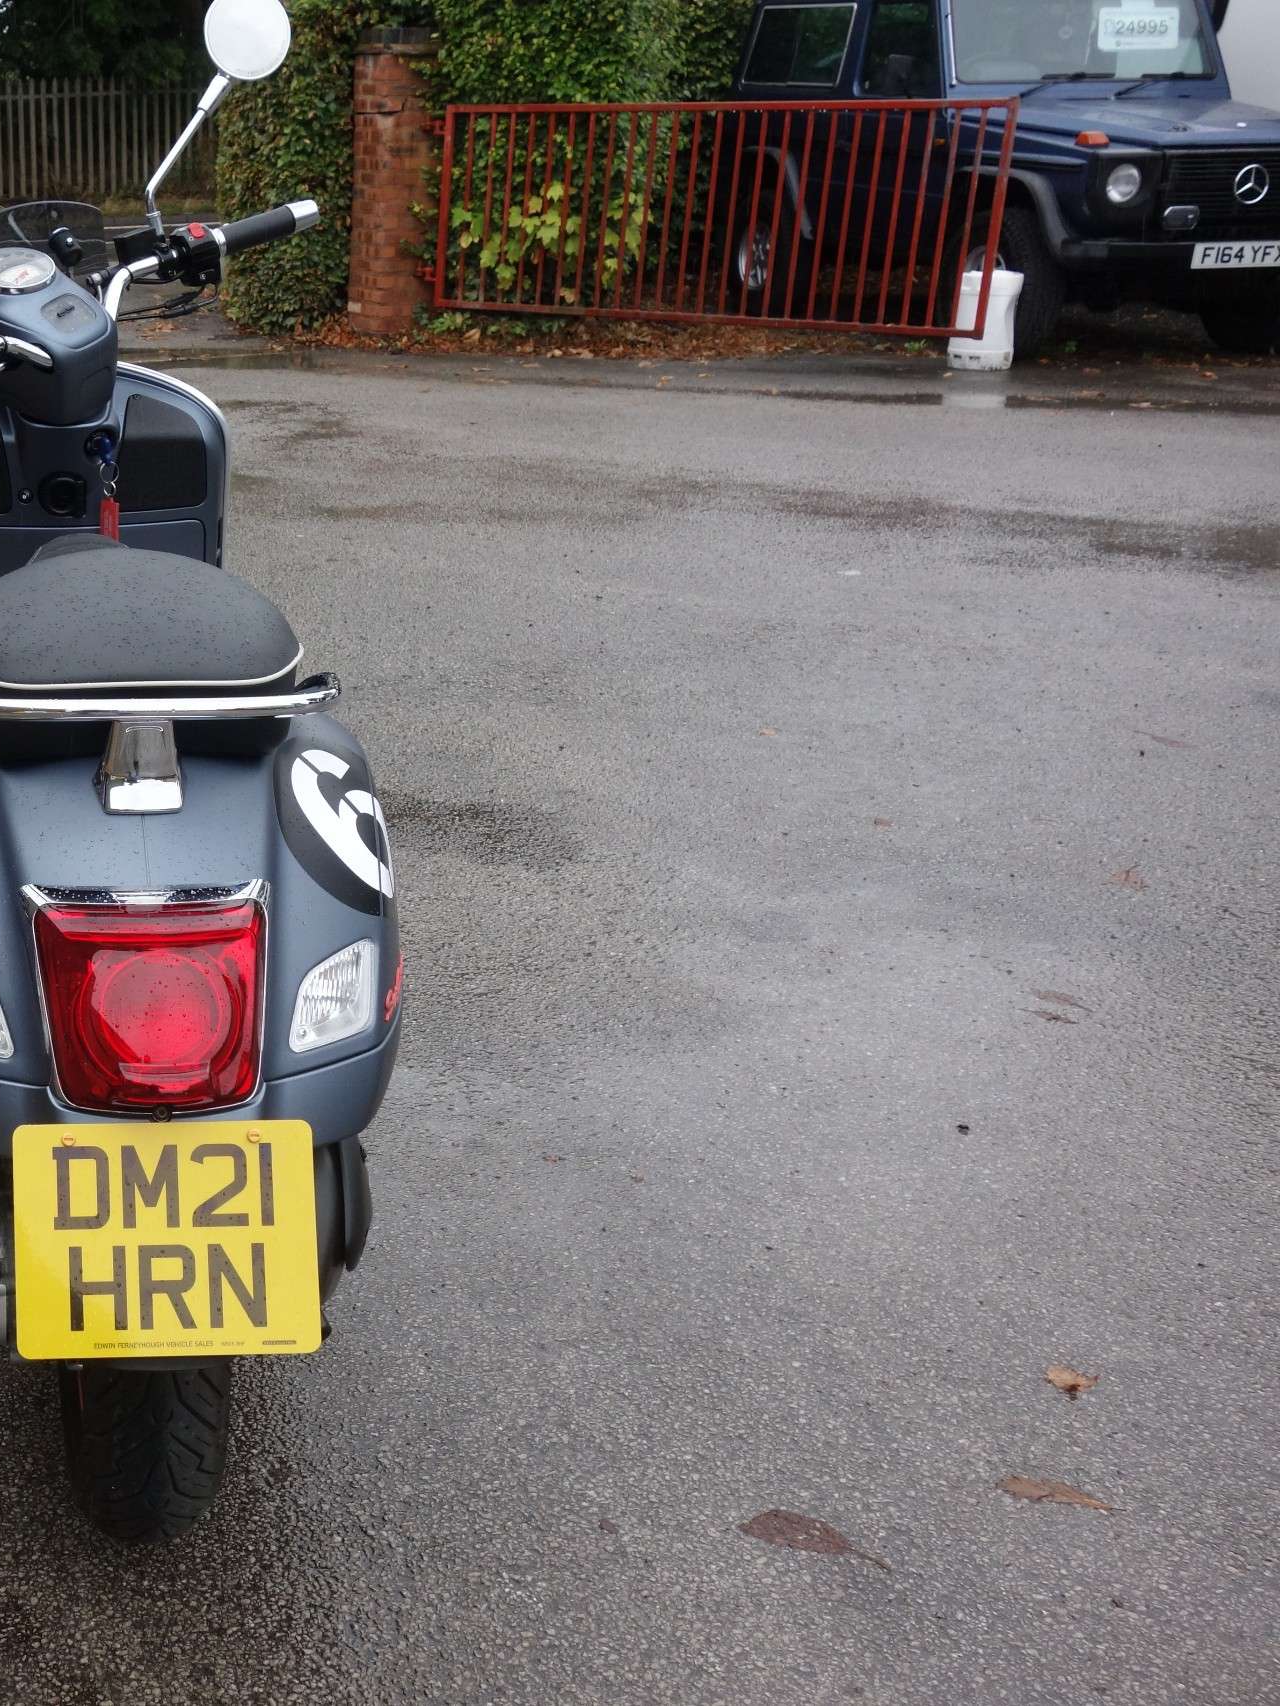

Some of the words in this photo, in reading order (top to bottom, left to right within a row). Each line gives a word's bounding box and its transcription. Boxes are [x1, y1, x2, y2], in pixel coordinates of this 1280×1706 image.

[1200, 246, 1245, 264] F164
[52, 1142, 275, 1230] DM21
[68, 1242, 268, 1332] HRN
